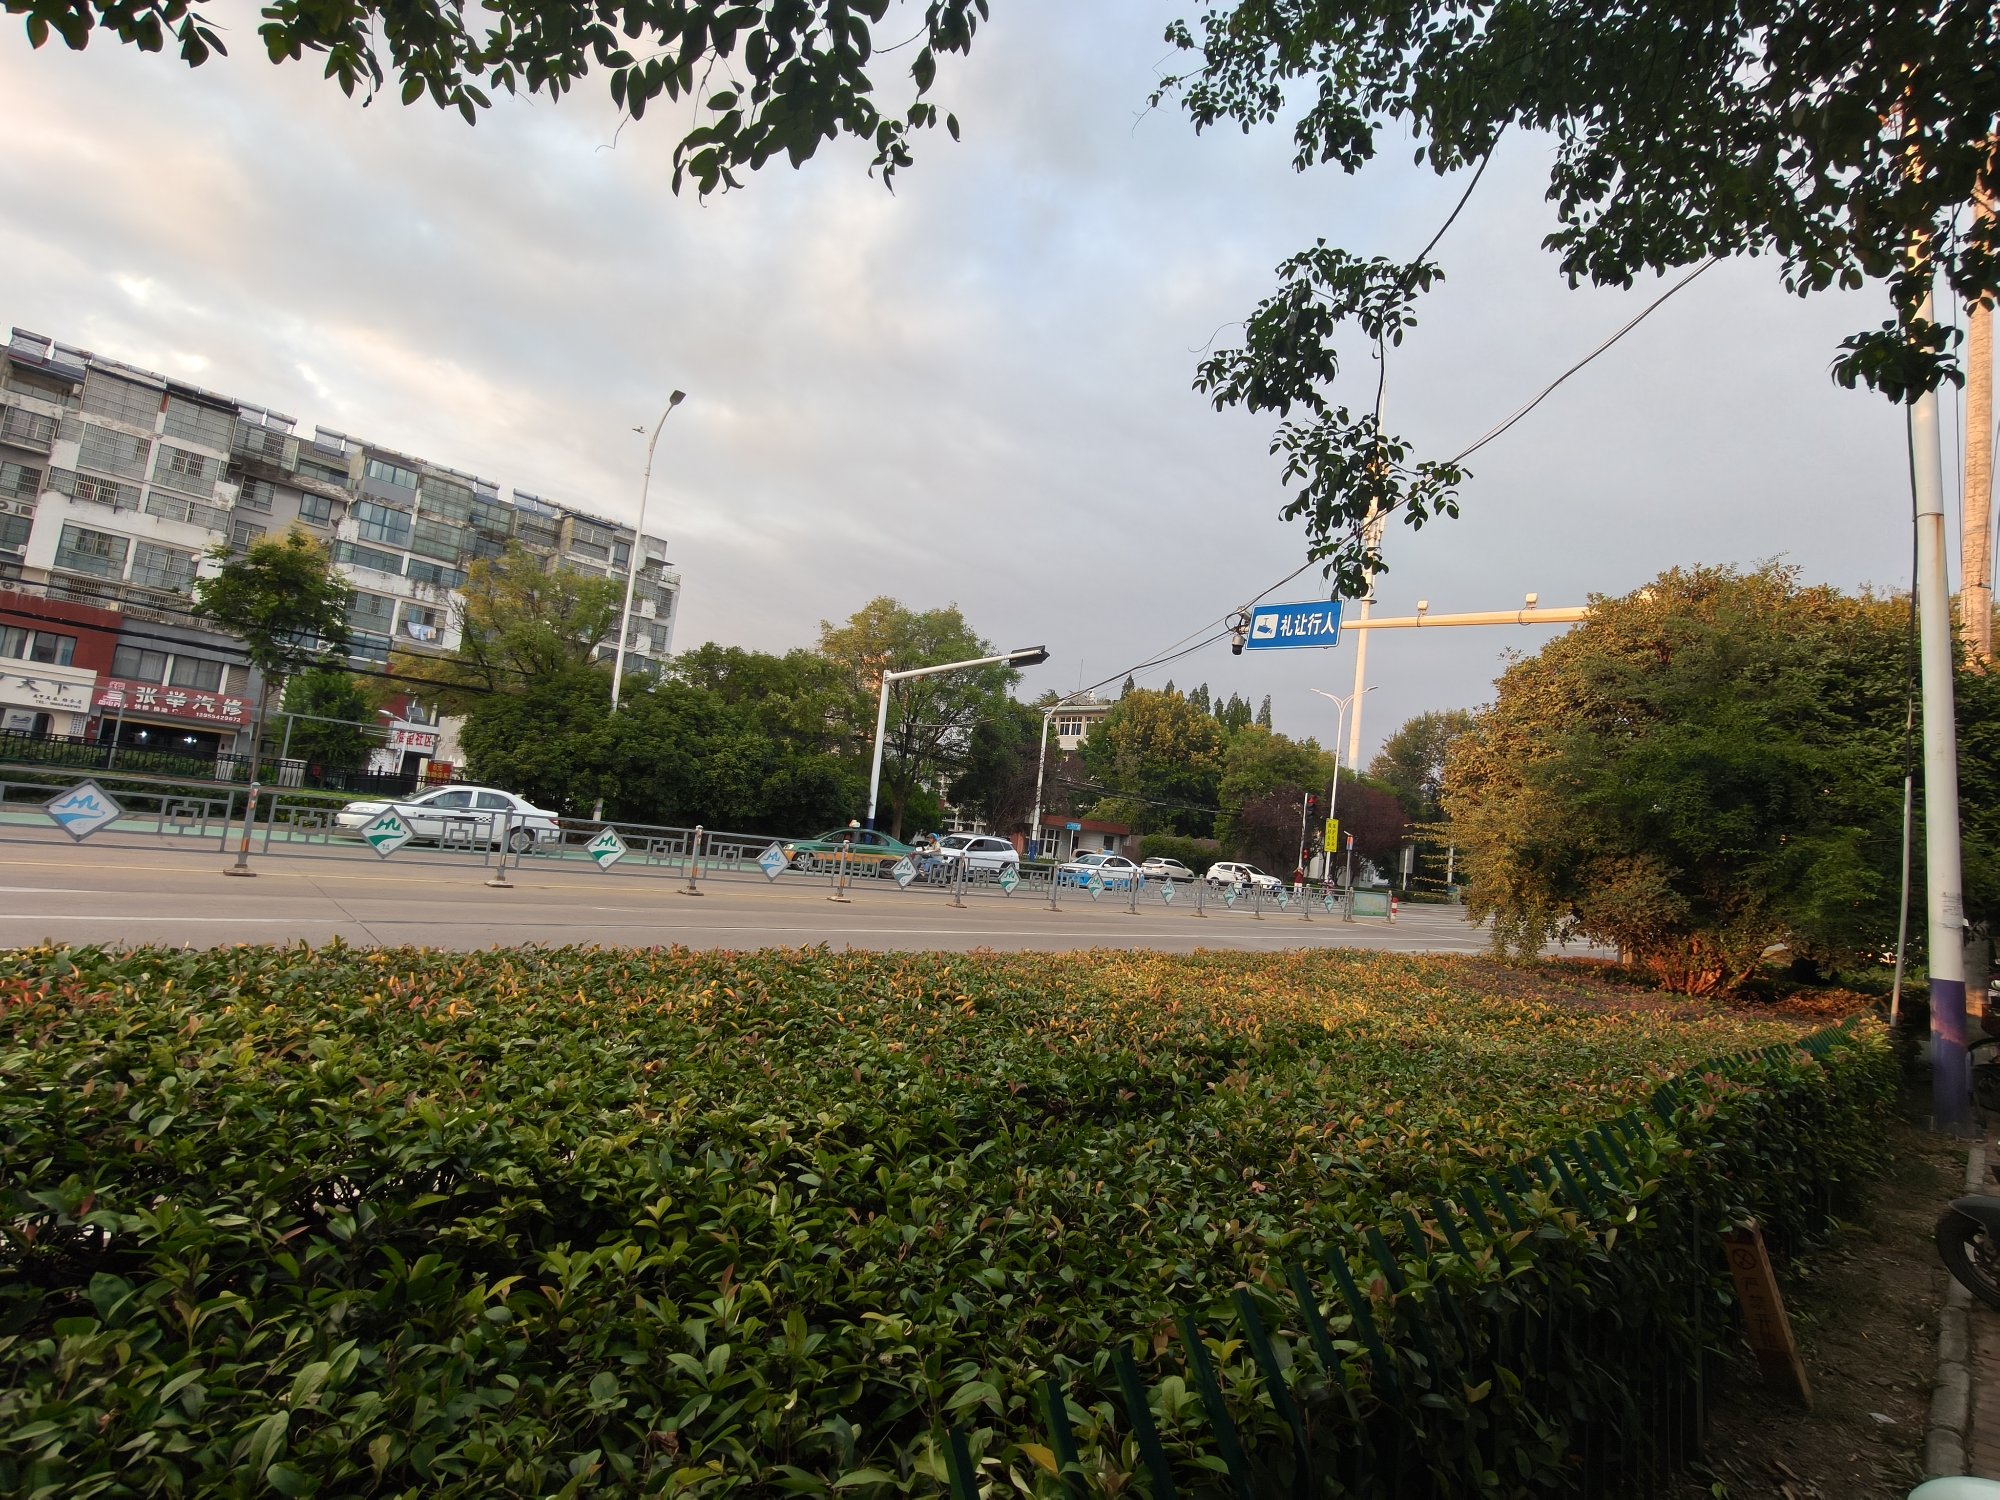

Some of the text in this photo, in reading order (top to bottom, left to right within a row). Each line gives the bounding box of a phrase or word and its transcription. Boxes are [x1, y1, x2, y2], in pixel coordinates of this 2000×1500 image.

[1280, 612, 1335, 637] 礼让行人
[136, 686, 242, 715] 张举汽修
